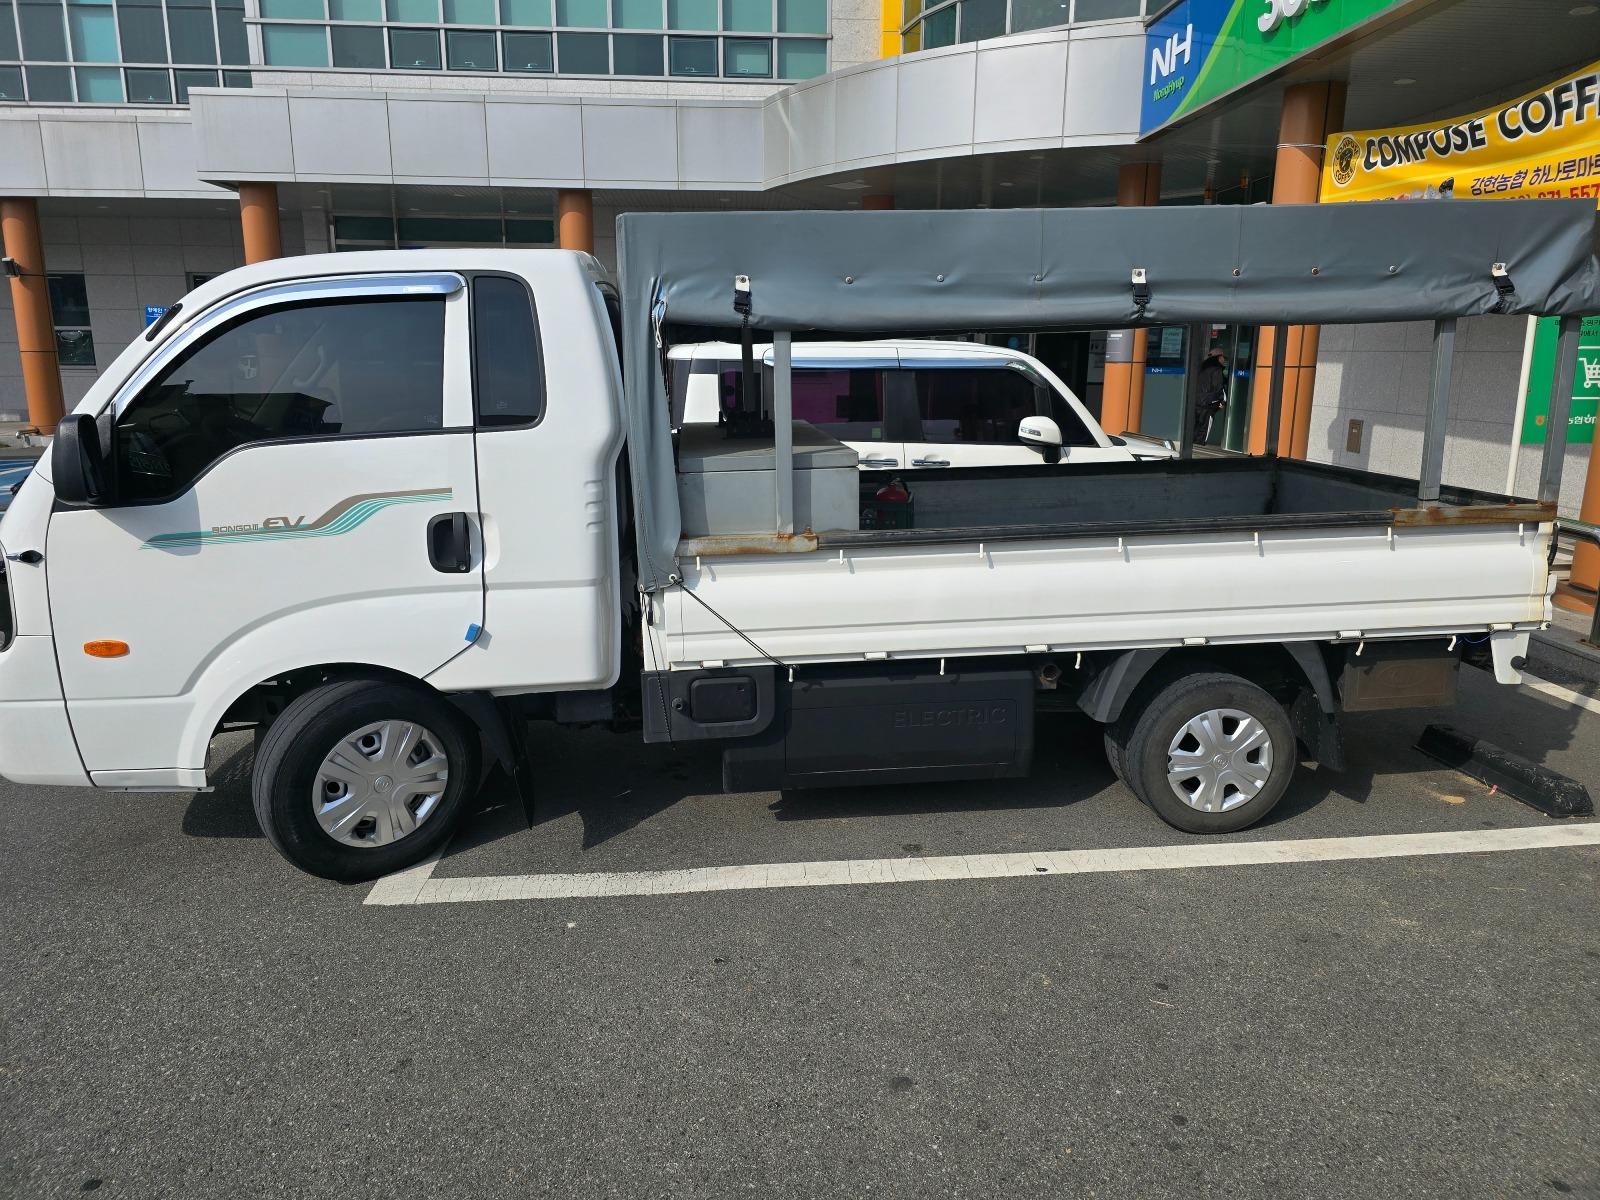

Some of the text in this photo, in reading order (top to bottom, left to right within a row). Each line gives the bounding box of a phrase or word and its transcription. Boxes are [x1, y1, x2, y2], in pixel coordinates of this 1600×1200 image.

[1151, 23, 1193, 86] NH
[1364, 74, 1600, 171] COMPOSE COFF
[1471, 169, 1528, 196] 강현농협
[263, 516, 306, 529] EV
